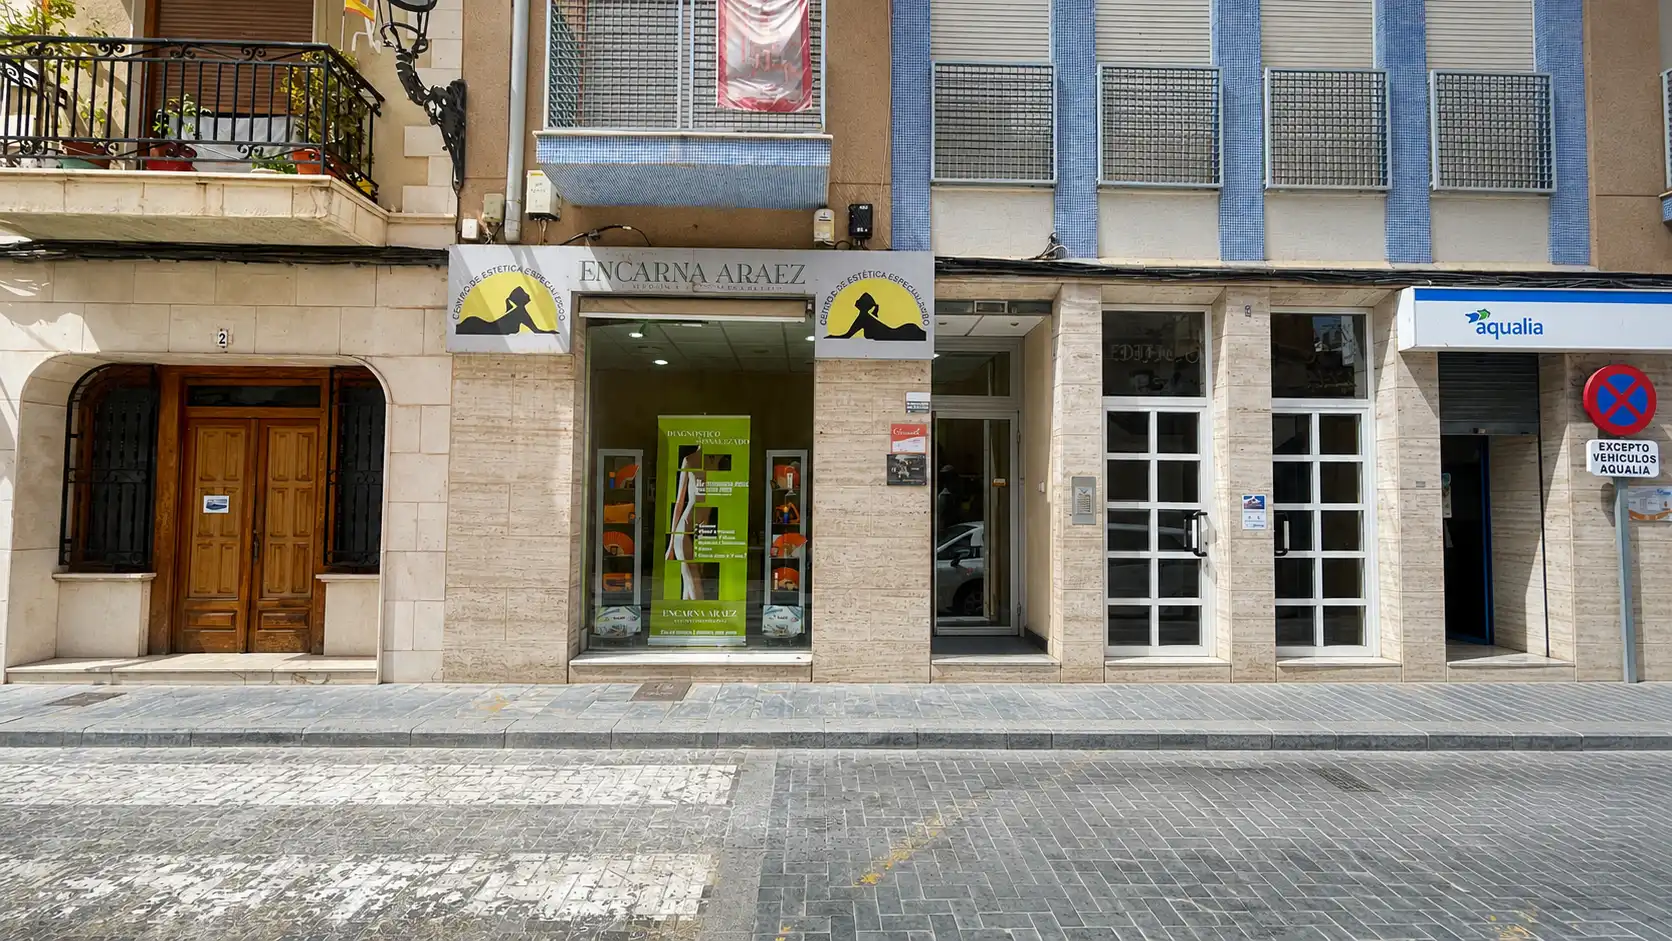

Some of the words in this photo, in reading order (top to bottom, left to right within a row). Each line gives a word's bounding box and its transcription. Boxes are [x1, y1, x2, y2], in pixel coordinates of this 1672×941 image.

[579, 260, 708, 283] ENCARNA
[715, 263, 806, 285] ARAEZ
[1476, 317, 1544, 340] aqualia
[219, 333, 225, 344] 2
[1599, 442, 1650, 452] EXCEPTO
[1593, 453, 1657, 464] VEHICULOS
[1600, 464, 1651, 475] AQUALIA
[662, 609, 705, 617] ENCARNA
[708, 609, 737, 617] ARAEZ
